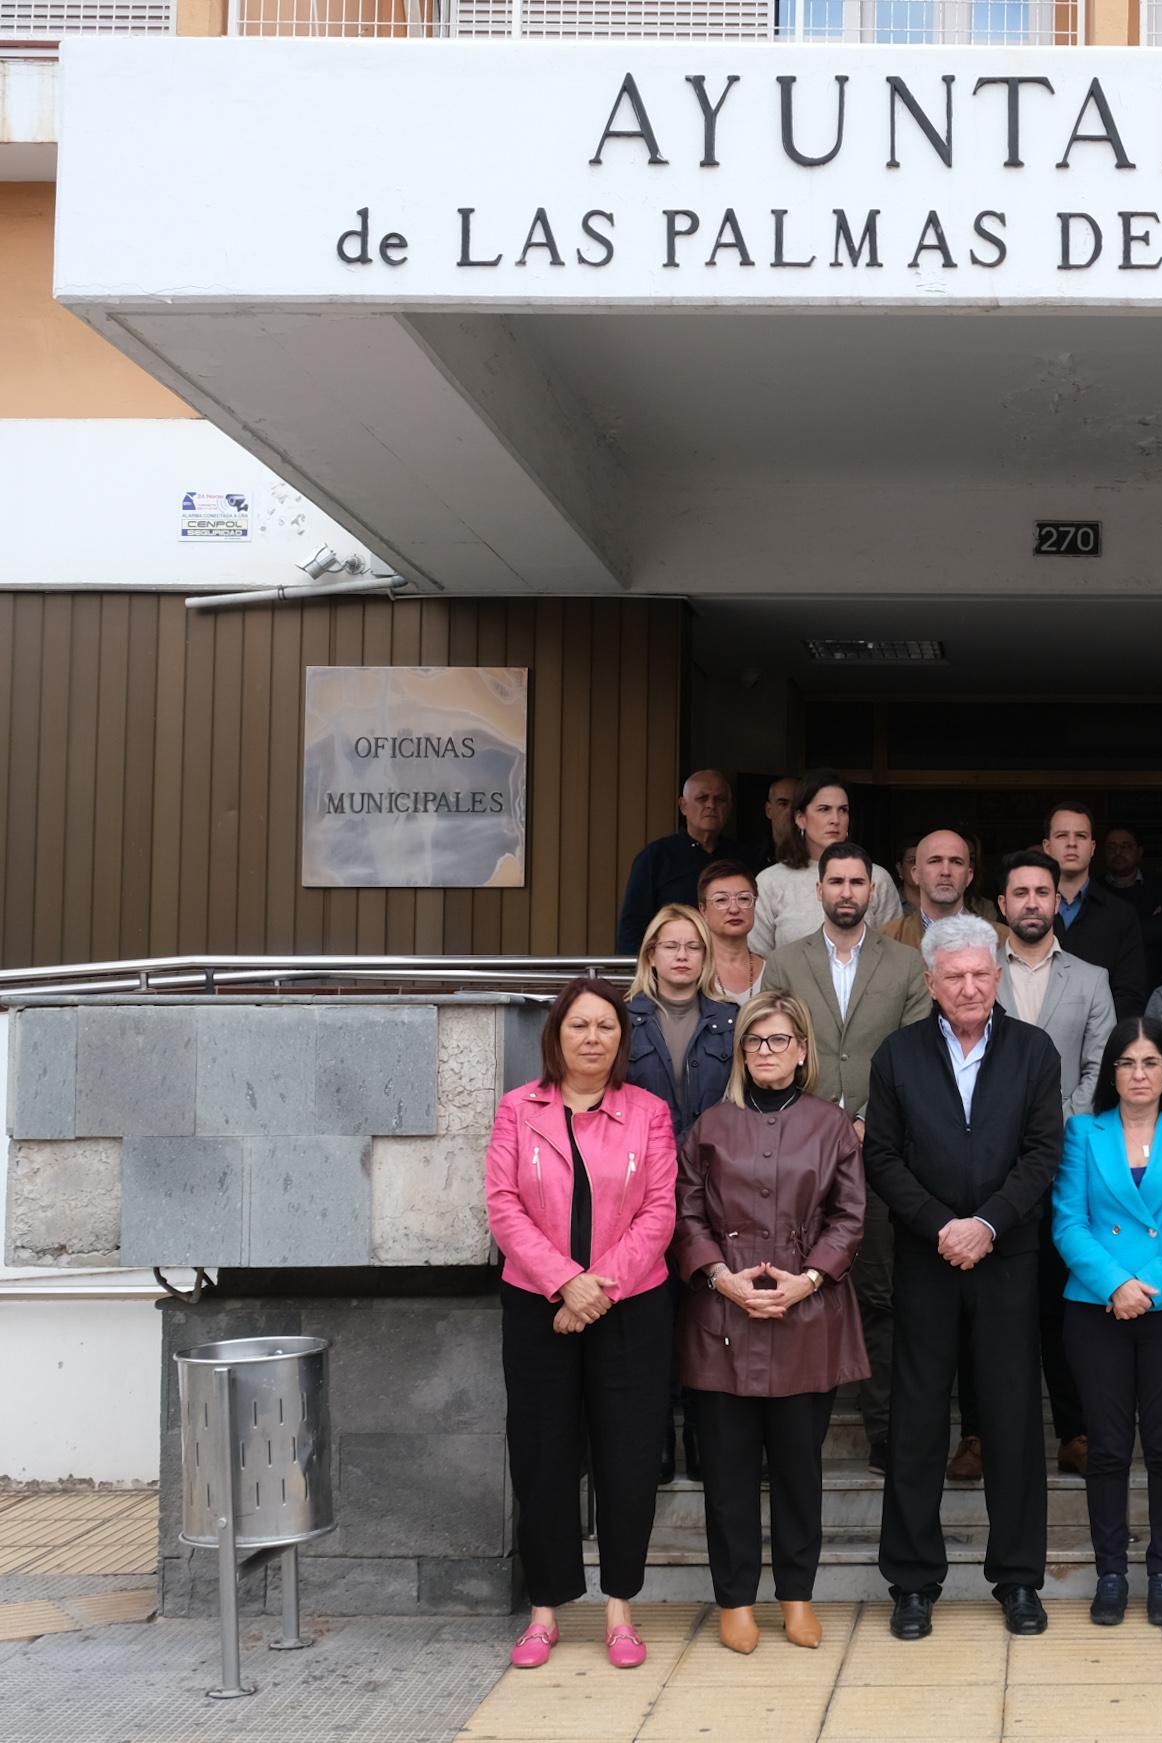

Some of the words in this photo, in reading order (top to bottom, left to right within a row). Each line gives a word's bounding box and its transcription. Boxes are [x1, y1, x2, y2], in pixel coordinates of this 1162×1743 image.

[336, 207, 408, 267] de
[456, 207, 615, 268] LAS
[662, 208, 1007, 269] PALMAS
[187, 520, 242, 528] CENPOL
[1039, 527, 1095, 552] 270
[354, 737, 475, 759] OFICINAS
[326, 792, 504, 814] MUNICIPALES
